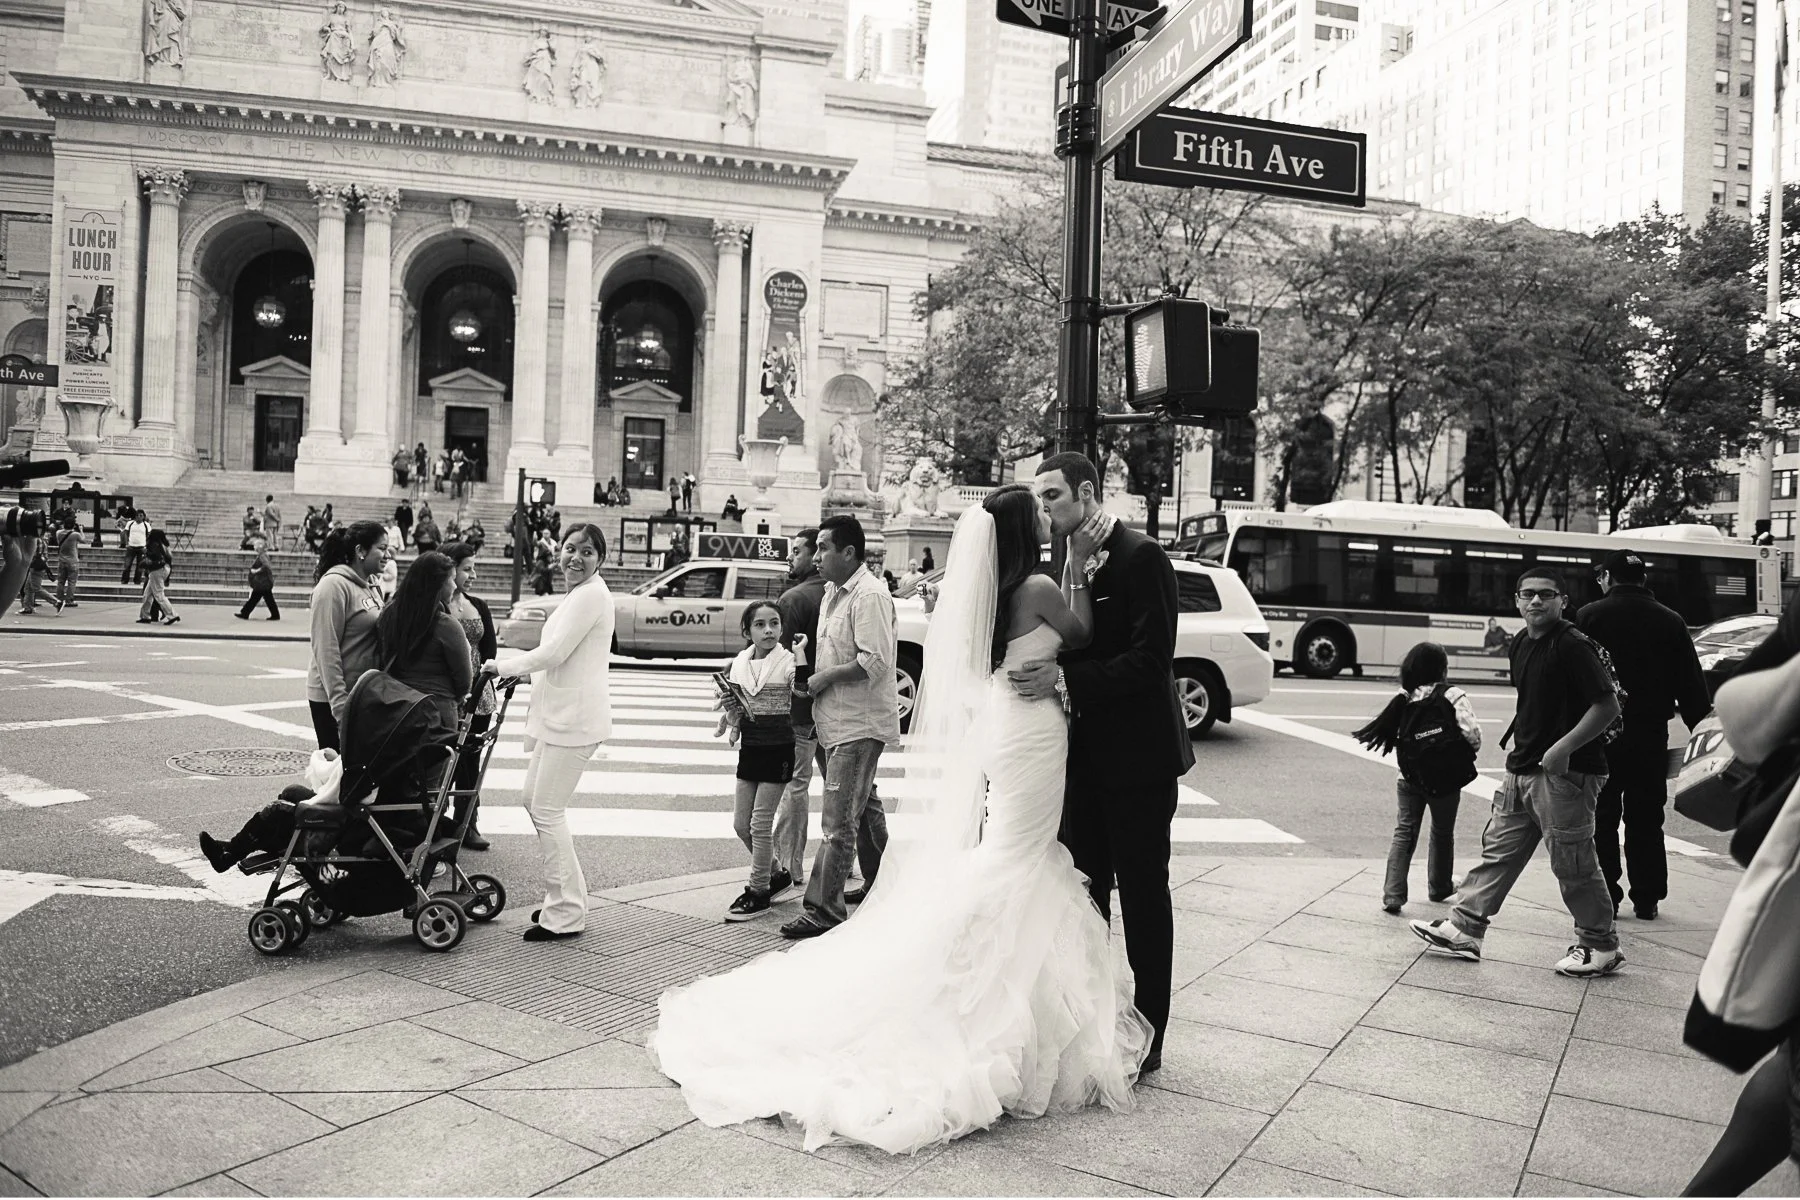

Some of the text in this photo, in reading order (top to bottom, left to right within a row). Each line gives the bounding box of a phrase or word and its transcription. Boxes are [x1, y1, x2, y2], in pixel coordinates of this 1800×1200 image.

[1119, 0, 1234, 117] Library Way
[273, 139, 316, 158] THE
[332, 145, 382, 162] NEW
[402, 152, 454, 170] YORK
[471, 158, 541, 178] PUBLIC
[559, 167, 638, 189] LIBRARY
[1173, 130, 1325, 180] Fifth Ave
[68, 227, 117, 250] LUNCH
[72, 250, 112, 272] HOUR
[769, 277, 804, 289] Charles
[769, 287, 805, 299] Dickens
[18, 368, 45, 381] Ave
[707, 535, 757, 558] 9W
[645, 612, 710, 625] NYC TAXI
